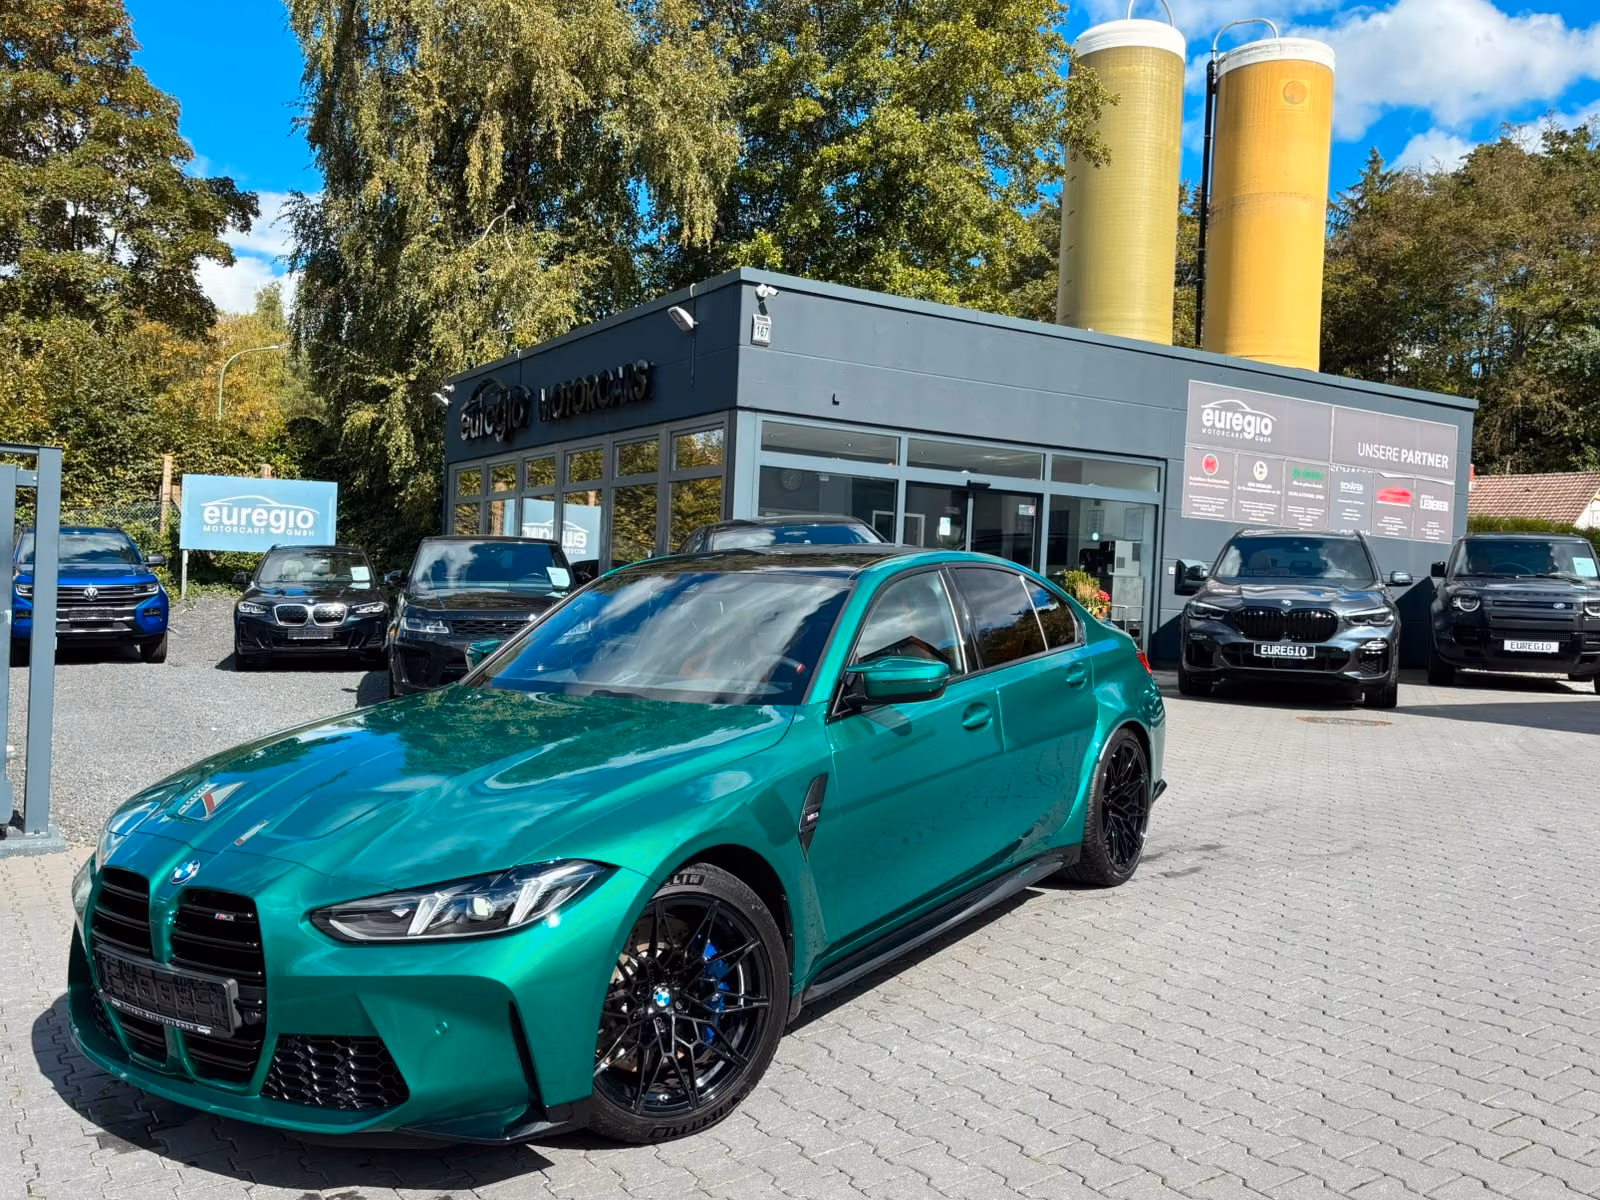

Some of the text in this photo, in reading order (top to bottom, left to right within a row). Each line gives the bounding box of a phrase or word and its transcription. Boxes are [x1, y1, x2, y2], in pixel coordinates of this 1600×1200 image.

[756, 326, 768, 337] 167
[460, 359, 653, 442] euregio MOTORCARS
[1202, 408, 1273, 440] euregio
[1202, 428, 1243, 439] MOTORCARS
[1357, 441, 1450, 469] UNSERE PARTNER
[203, 505, 314, 534] euregio
[203, 525, 315, 537] MOTORCARS GMBH
[1260, 644, 1308, 657] EUREGIO
[1510, 641, 1552, 651] EUREGIO
